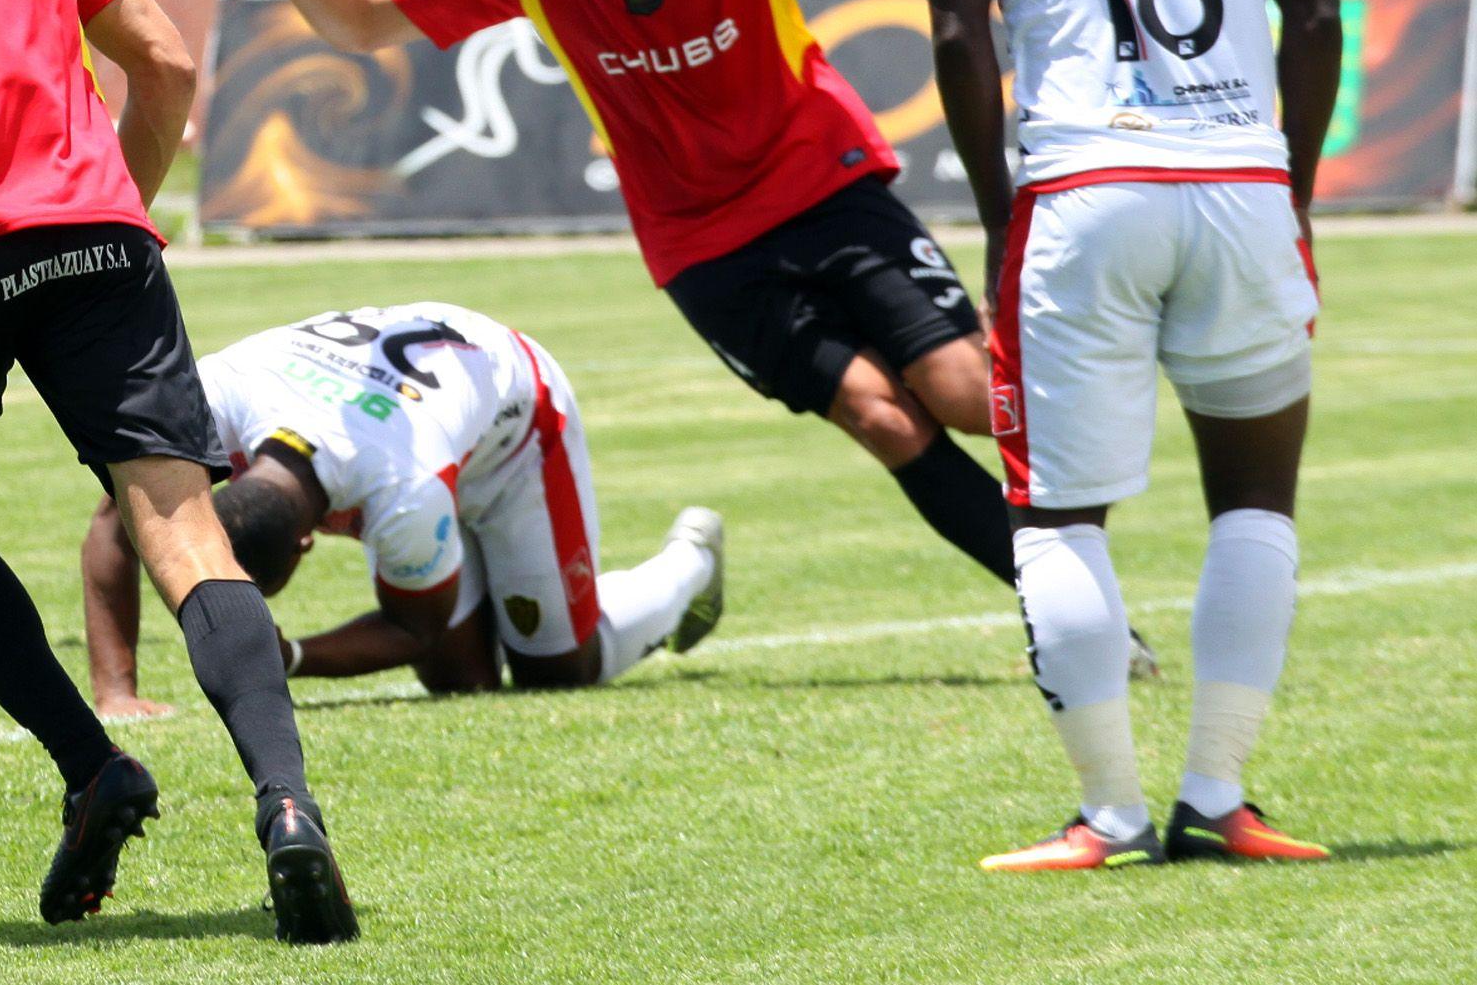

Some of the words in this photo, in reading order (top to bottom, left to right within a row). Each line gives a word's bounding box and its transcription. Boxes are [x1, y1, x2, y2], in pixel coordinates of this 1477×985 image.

[598, 18, 740, 75] CHUBB
[0, 244, 105, 301] PLASTIAZUAY
[106, 243, 131, 269] S.A.
